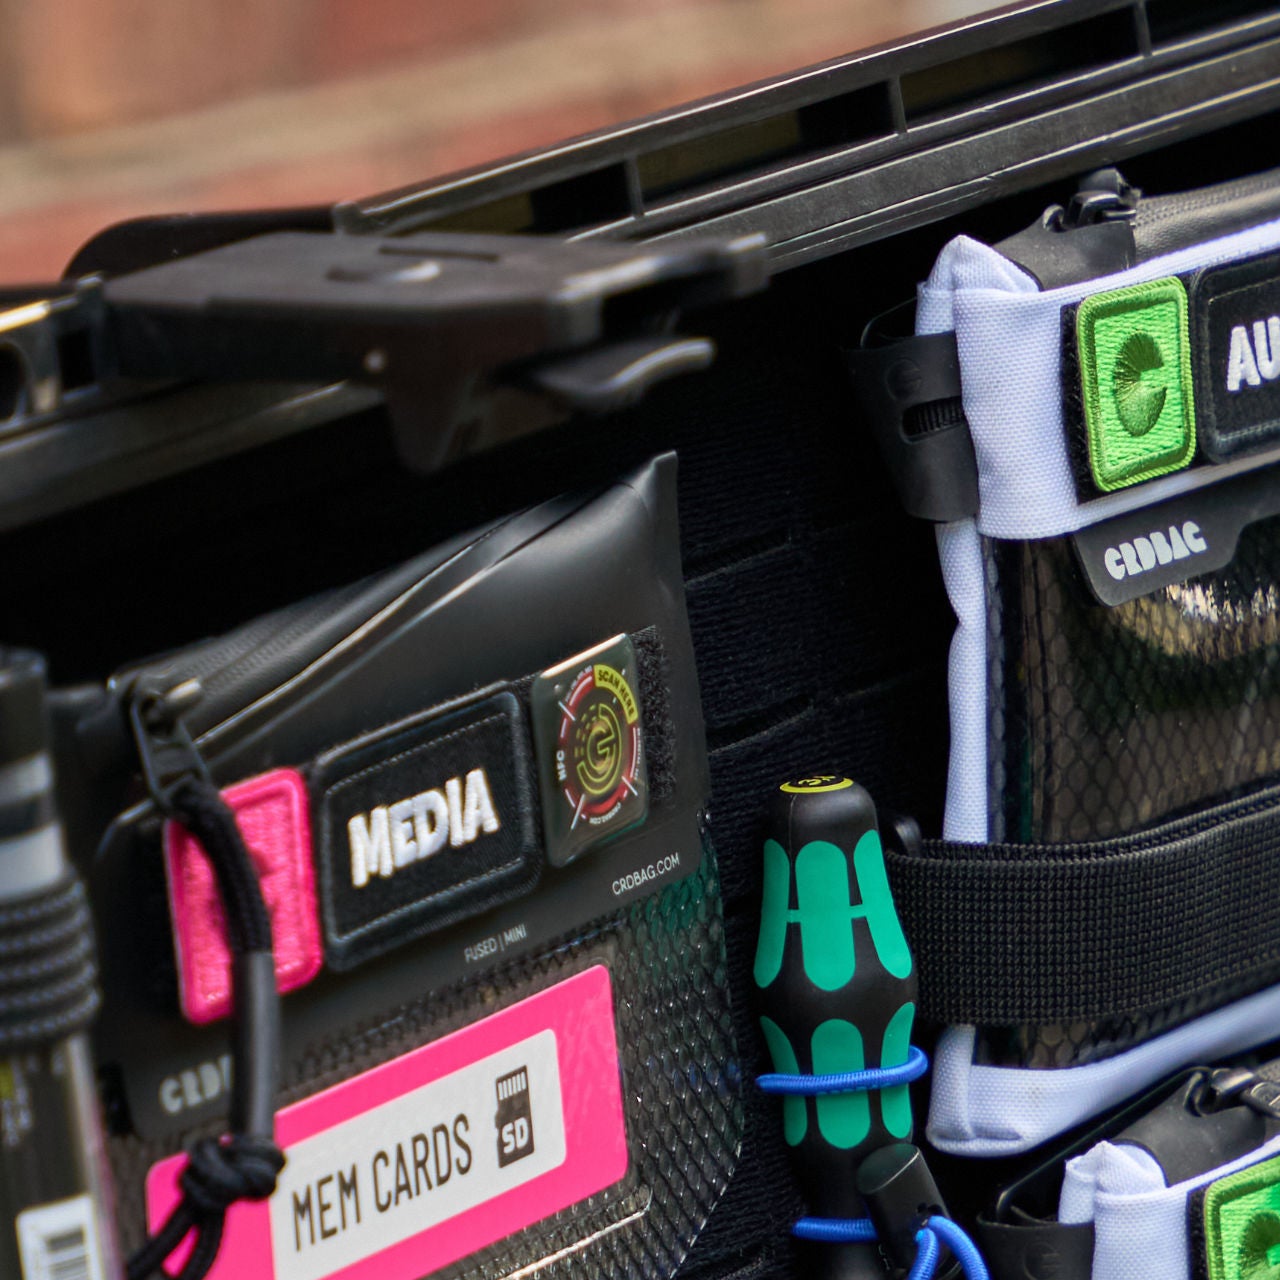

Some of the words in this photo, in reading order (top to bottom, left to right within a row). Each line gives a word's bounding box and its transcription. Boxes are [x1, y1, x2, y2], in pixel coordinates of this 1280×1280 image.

[597, 669, 620, 691] SCAN
[619, 684, 636, 717] HERE
[347, 767, 499, 889] MEDIA
[611, 851, 681, 896] CRDBAG.COM
[463, 936, 498, 964] FUSED
[503, 923, 528, 946] MINI
[501, 1116, 531, 1154] SD
[292, 1163, 362, 1253] MEM
[371, 1112, 473, 1214] CARDS
